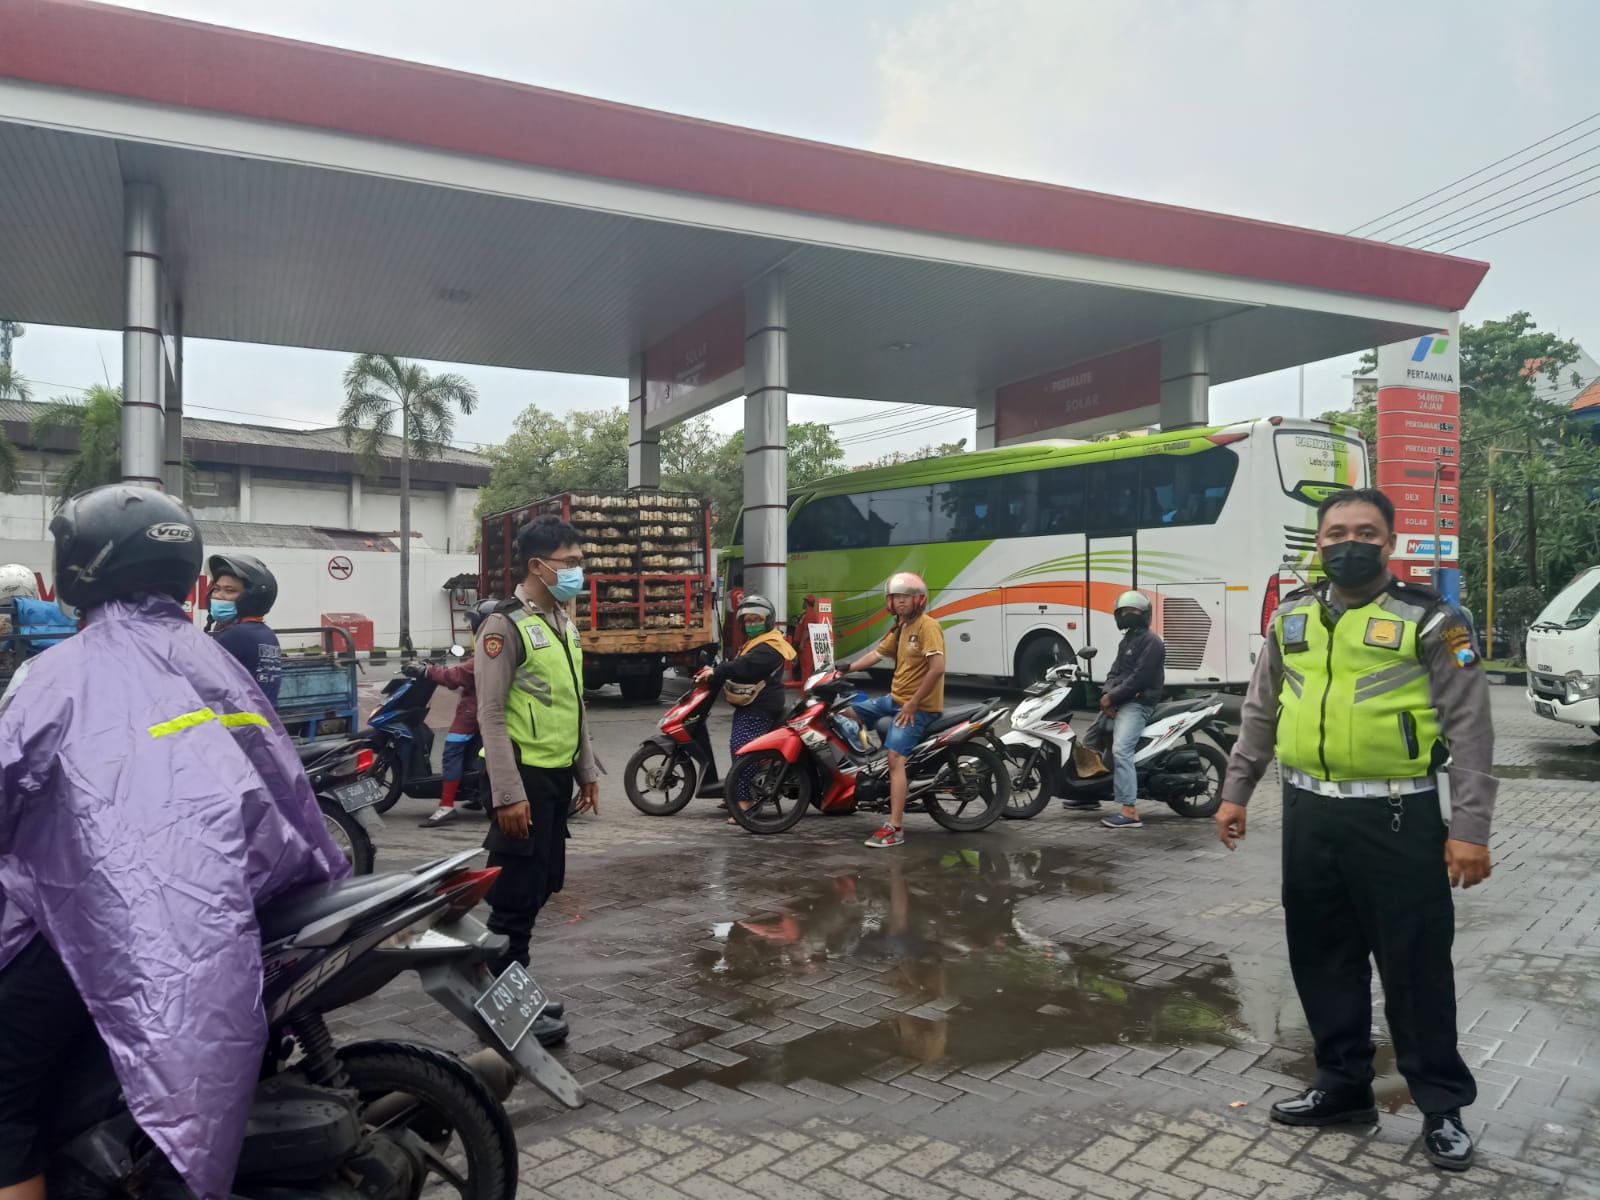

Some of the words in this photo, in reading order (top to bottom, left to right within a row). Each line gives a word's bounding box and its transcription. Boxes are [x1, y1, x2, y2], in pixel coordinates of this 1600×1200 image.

[1052, 371, 1093, 392] PERTALITE
[1407, 369, 1453, 383] PERTAMINA
[814, 642, 831, 654] BBM
[479, 1007, 496, 1025] L
[509, 967, 531, 991] SA
